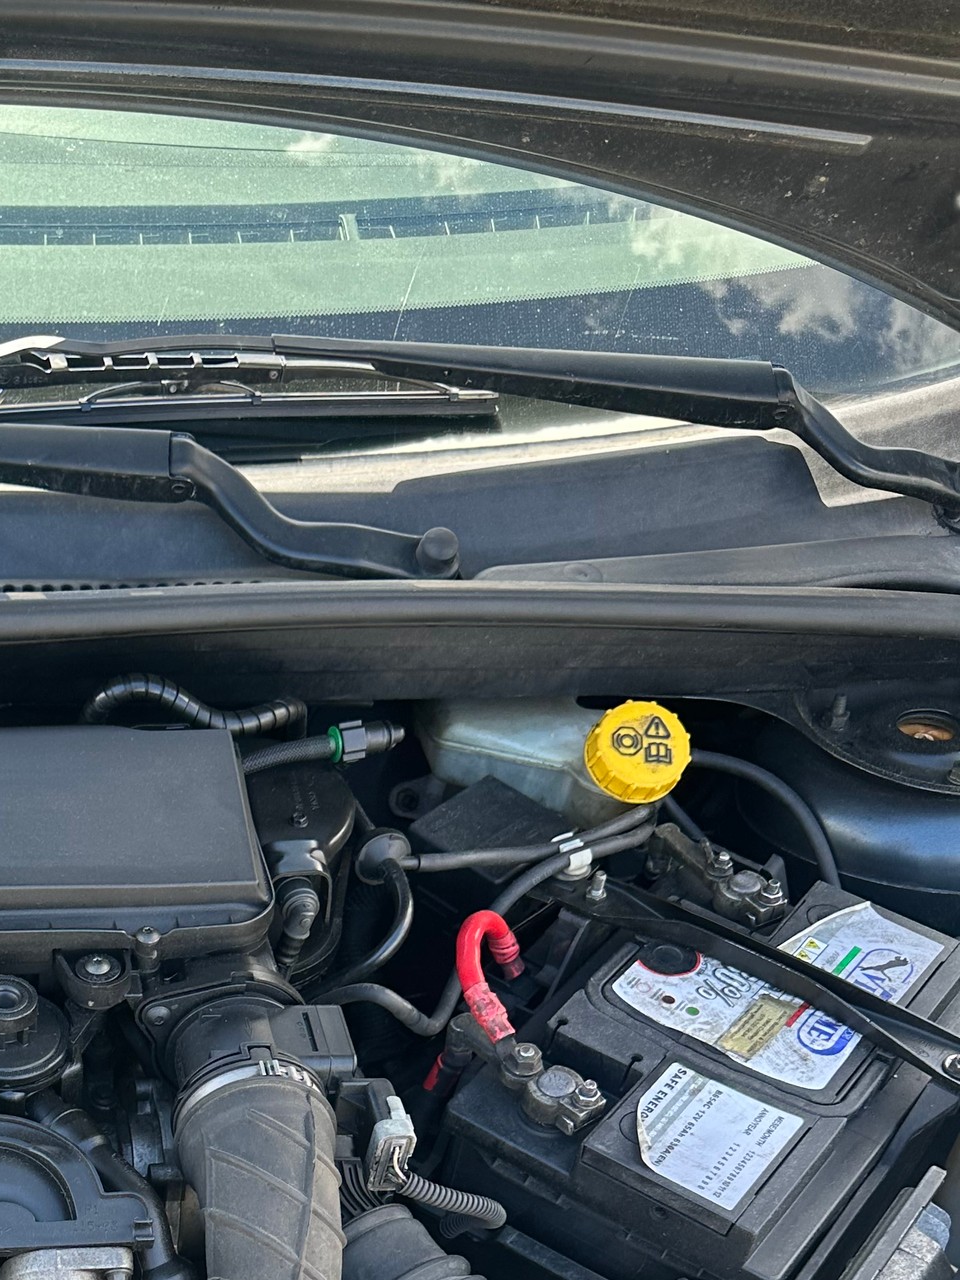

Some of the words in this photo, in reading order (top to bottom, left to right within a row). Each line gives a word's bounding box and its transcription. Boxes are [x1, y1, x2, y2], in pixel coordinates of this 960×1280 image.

[664, 1068, 687, 1091] SAFE
[640, 1090, 668, 1121] ENERG
[692, 1110, 706, 1123] 12V
[678, 1121, 695, 1138] 65Ah
[651, 1138, 681, 1167] 630A(EN)
